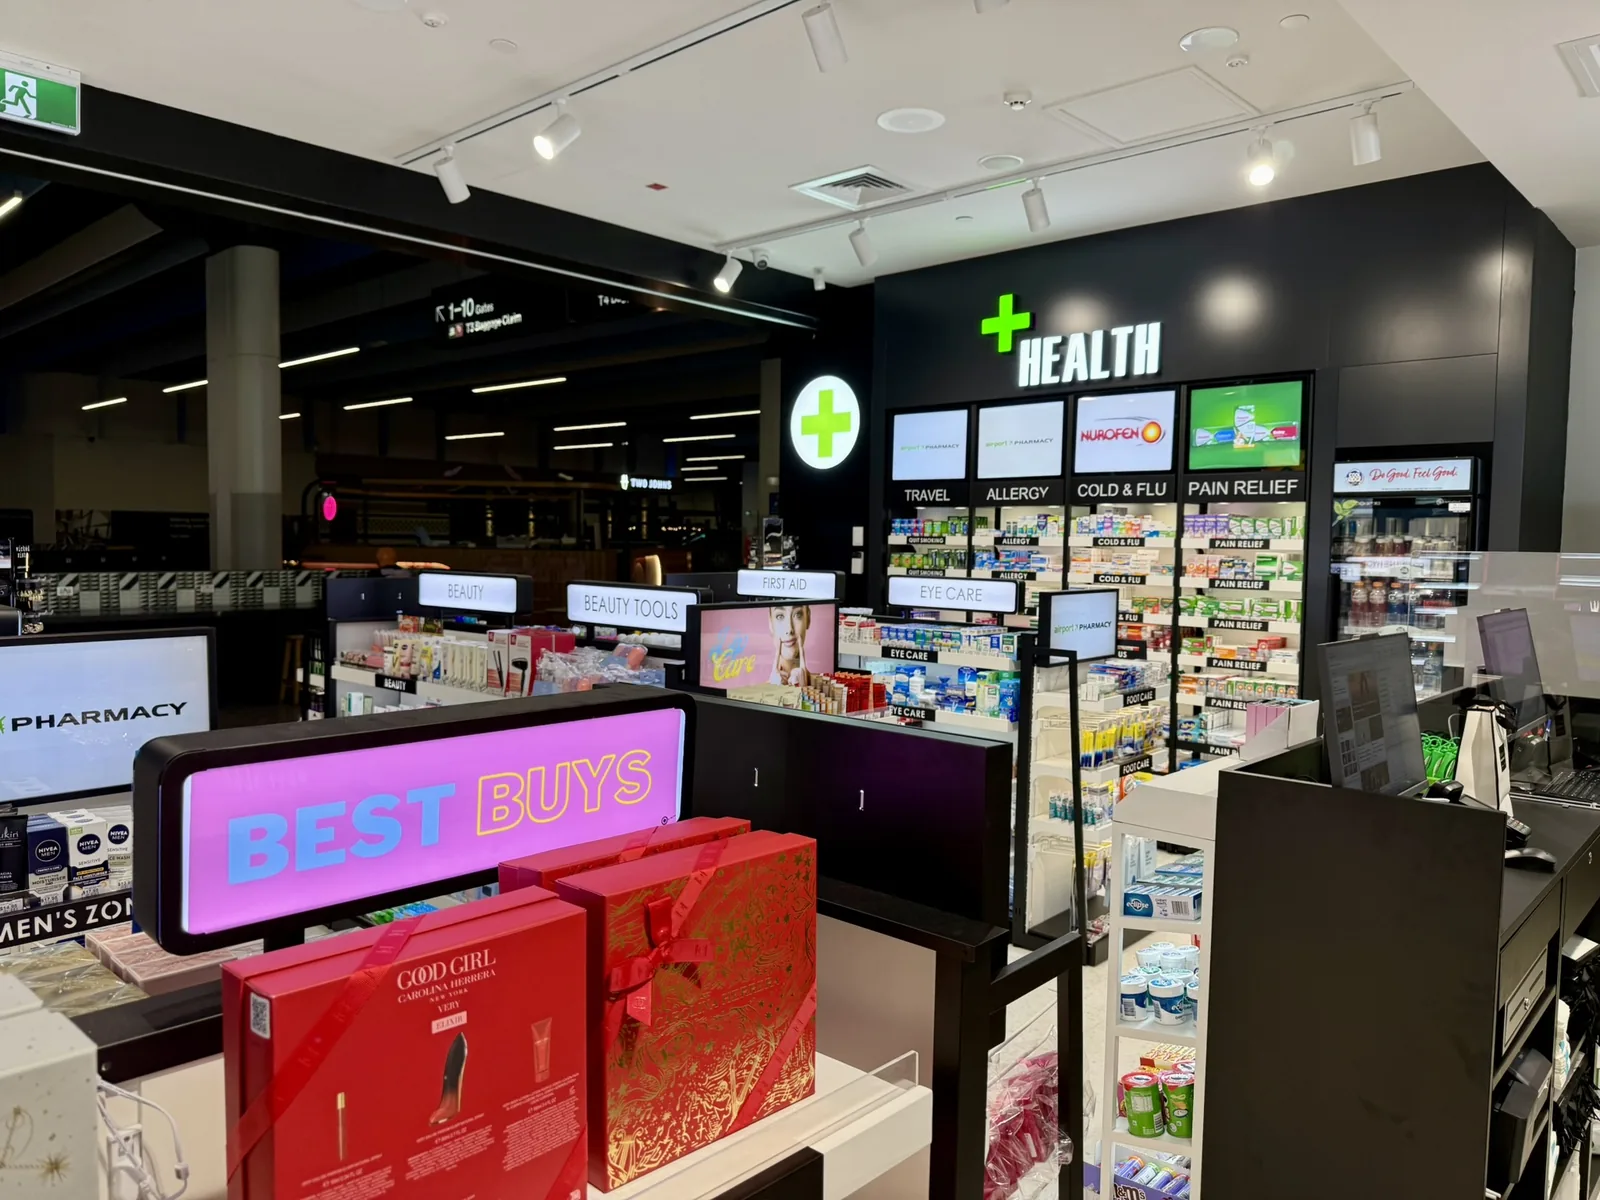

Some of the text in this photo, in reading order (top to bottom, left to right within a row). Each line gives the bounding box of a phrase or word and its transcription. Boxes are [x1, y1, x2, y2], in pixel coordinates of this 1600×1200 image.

[475, 303, 494, 315] Gates
[502, 312, 522, 326] Claim
[1018, 322, 1161, 387] HEALTH
[1080, 427, 1139, 442] NUROFEN
[1369, 468, 1385, 480] Do
[986, 486, 1049, 500] ALLERGY
[1078, 482, 1167, 497] COLD & FLU
[1188, 479, 1299, 496] PAIN RELIEF
[905, 489, 950, 501] TRAVEL
[763, 578, 807, 590] FIRST AID
[448, 584, 484, 600] BEAUTY
[920, 585, 982, 601] EYE CARE
[585, 595, 678, 620] BEAUTY TOOLS
[1054, 621, 1111, 634] airport PHARMACY
[1236, 621, 1262, 629] RELIEF
[891, 649, 928, 660] EYE CARE
[712, 649, 756, 682] Care
[1213, 659, 1261, 670] PAIN RELIEF
[384, 678, 406, 690] BEAUTY
[1127, 691, 1153, 704] FOOT CARE
[1211, 699, 1246, 710] PAIN REL
[12, 702, 187, 731] PHARMACY
[903, 708, 925, 718] CARE
[1210, 747, 1230, 755] PAIN
[1123, 759, 1150, 773] FOOT CARE
[228, 750, 652, 885] BEST BUYS
[32, 876, 66, 885] MOISTURISER
[0, 909, 77, 943] MEN'S
[397, 949, 496, 990] GOOD GIRL
[398, 969, 496, 1003] CAROLINA HERRERA
[449, 988, 468, 997] YORK
[437, 1000, 460, 1013] VERY
[436, 1015, 463, 1030] ELIXIR
